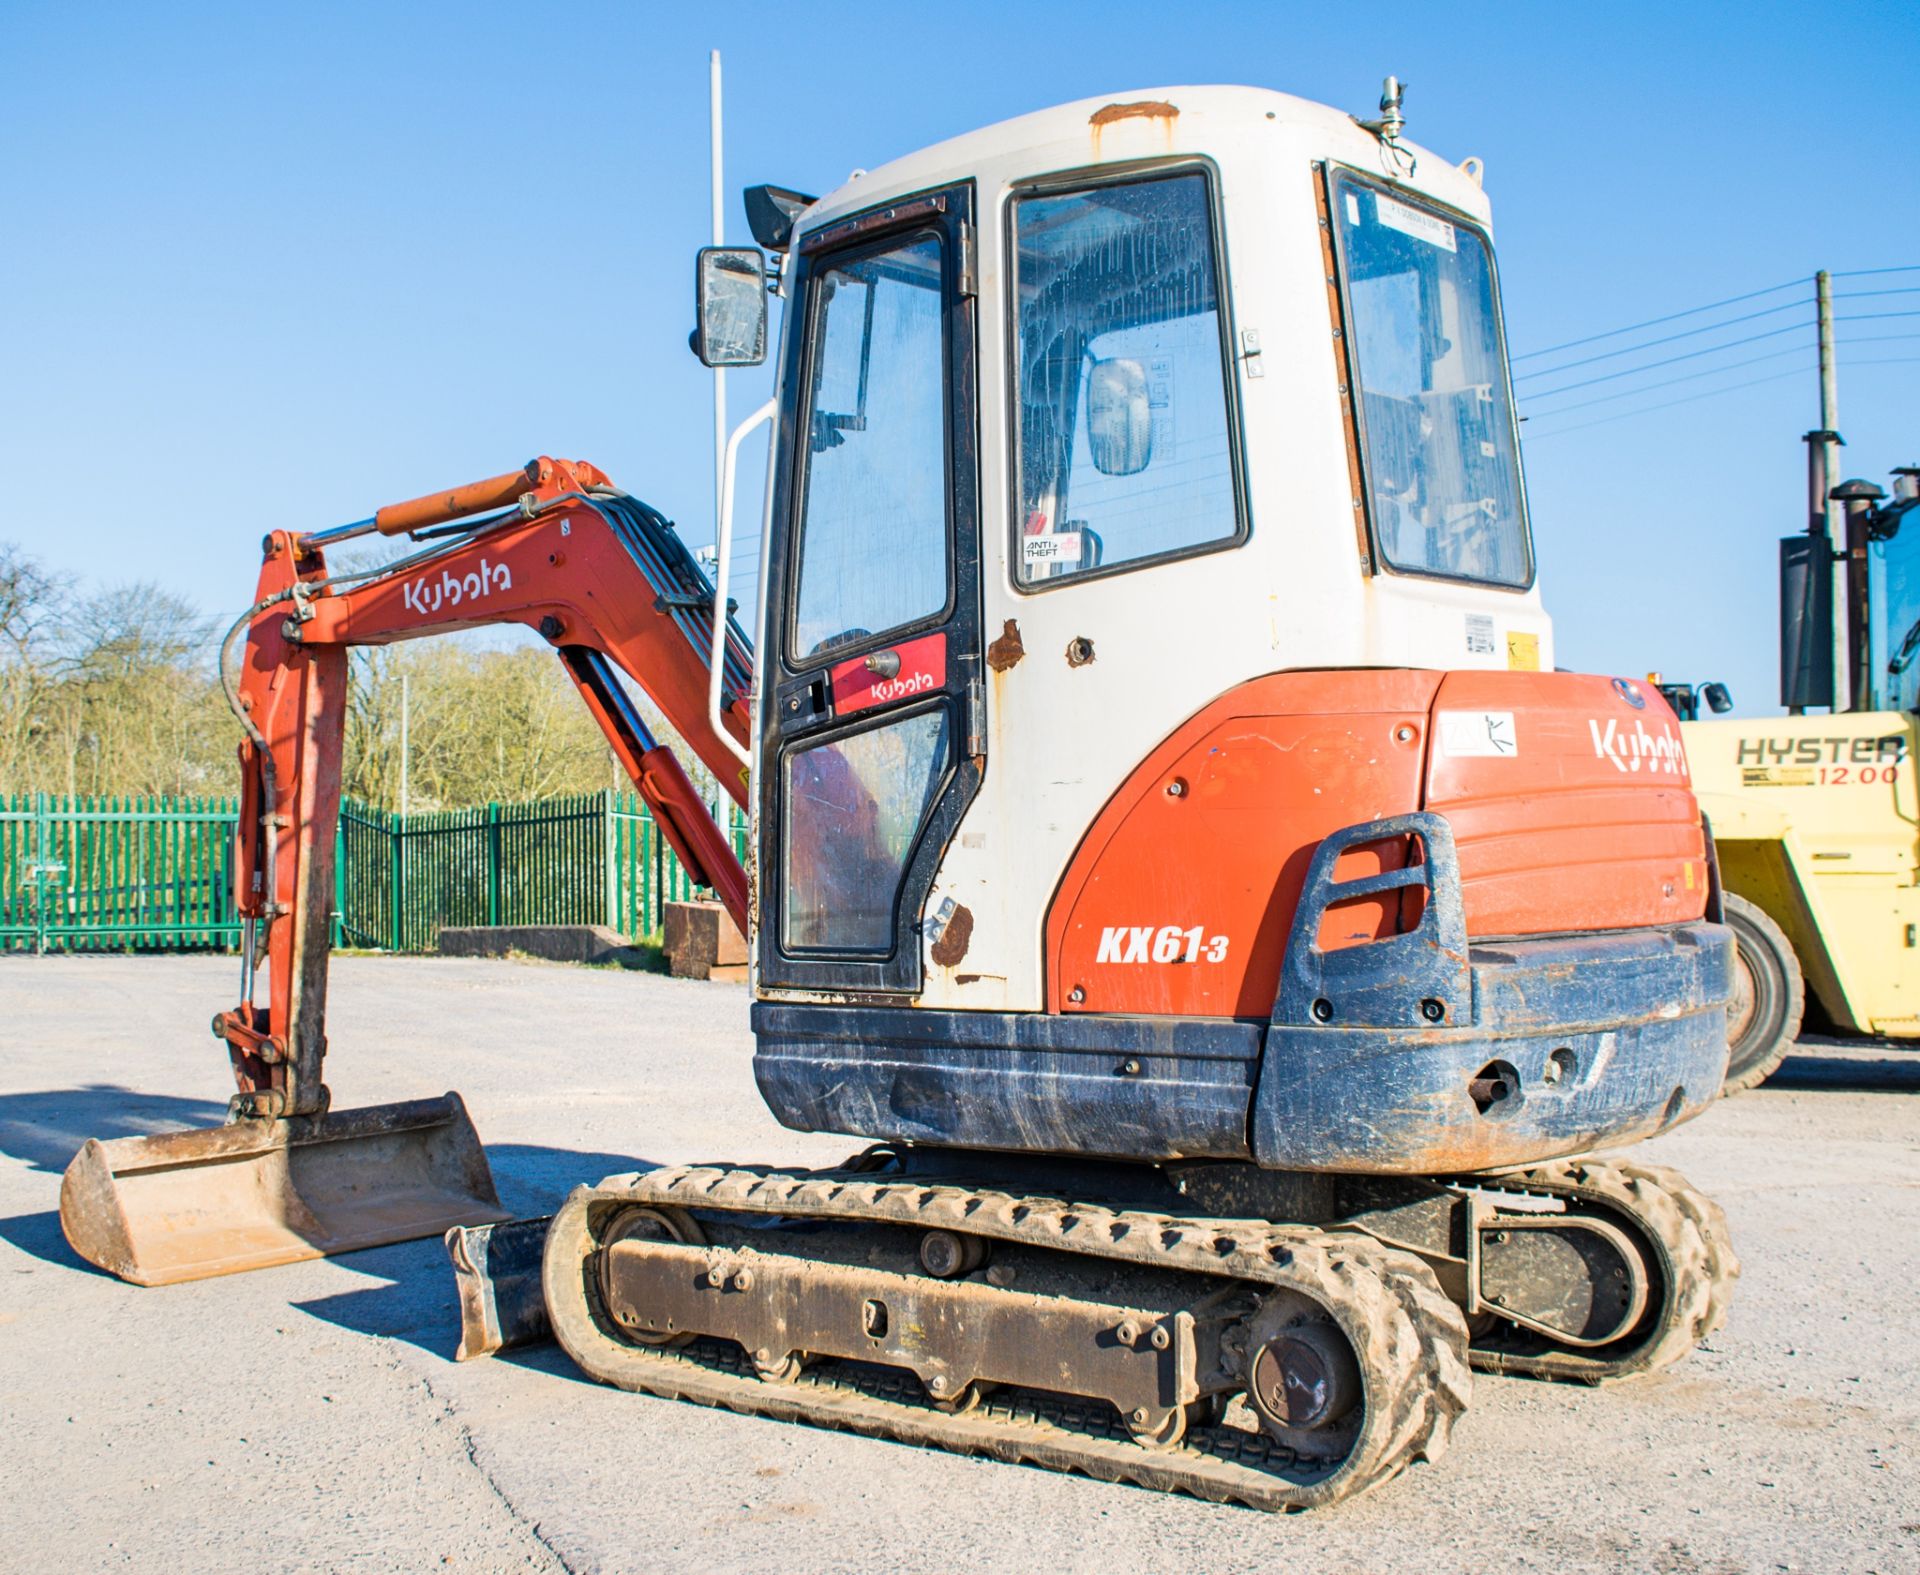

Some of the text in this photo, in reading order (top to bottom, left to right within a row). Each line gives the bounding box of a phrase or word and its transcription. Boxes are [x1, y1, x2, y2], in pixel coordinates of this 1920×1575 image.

[1025, 549, 1058, 557] THEFT
[403, 559, 512, 614] Kubota
[871, 671, 934, 701] Kubota
[1736, 736, 1905, 765] HYSTER
[1096, 926, 1230, 964] KX61-3
